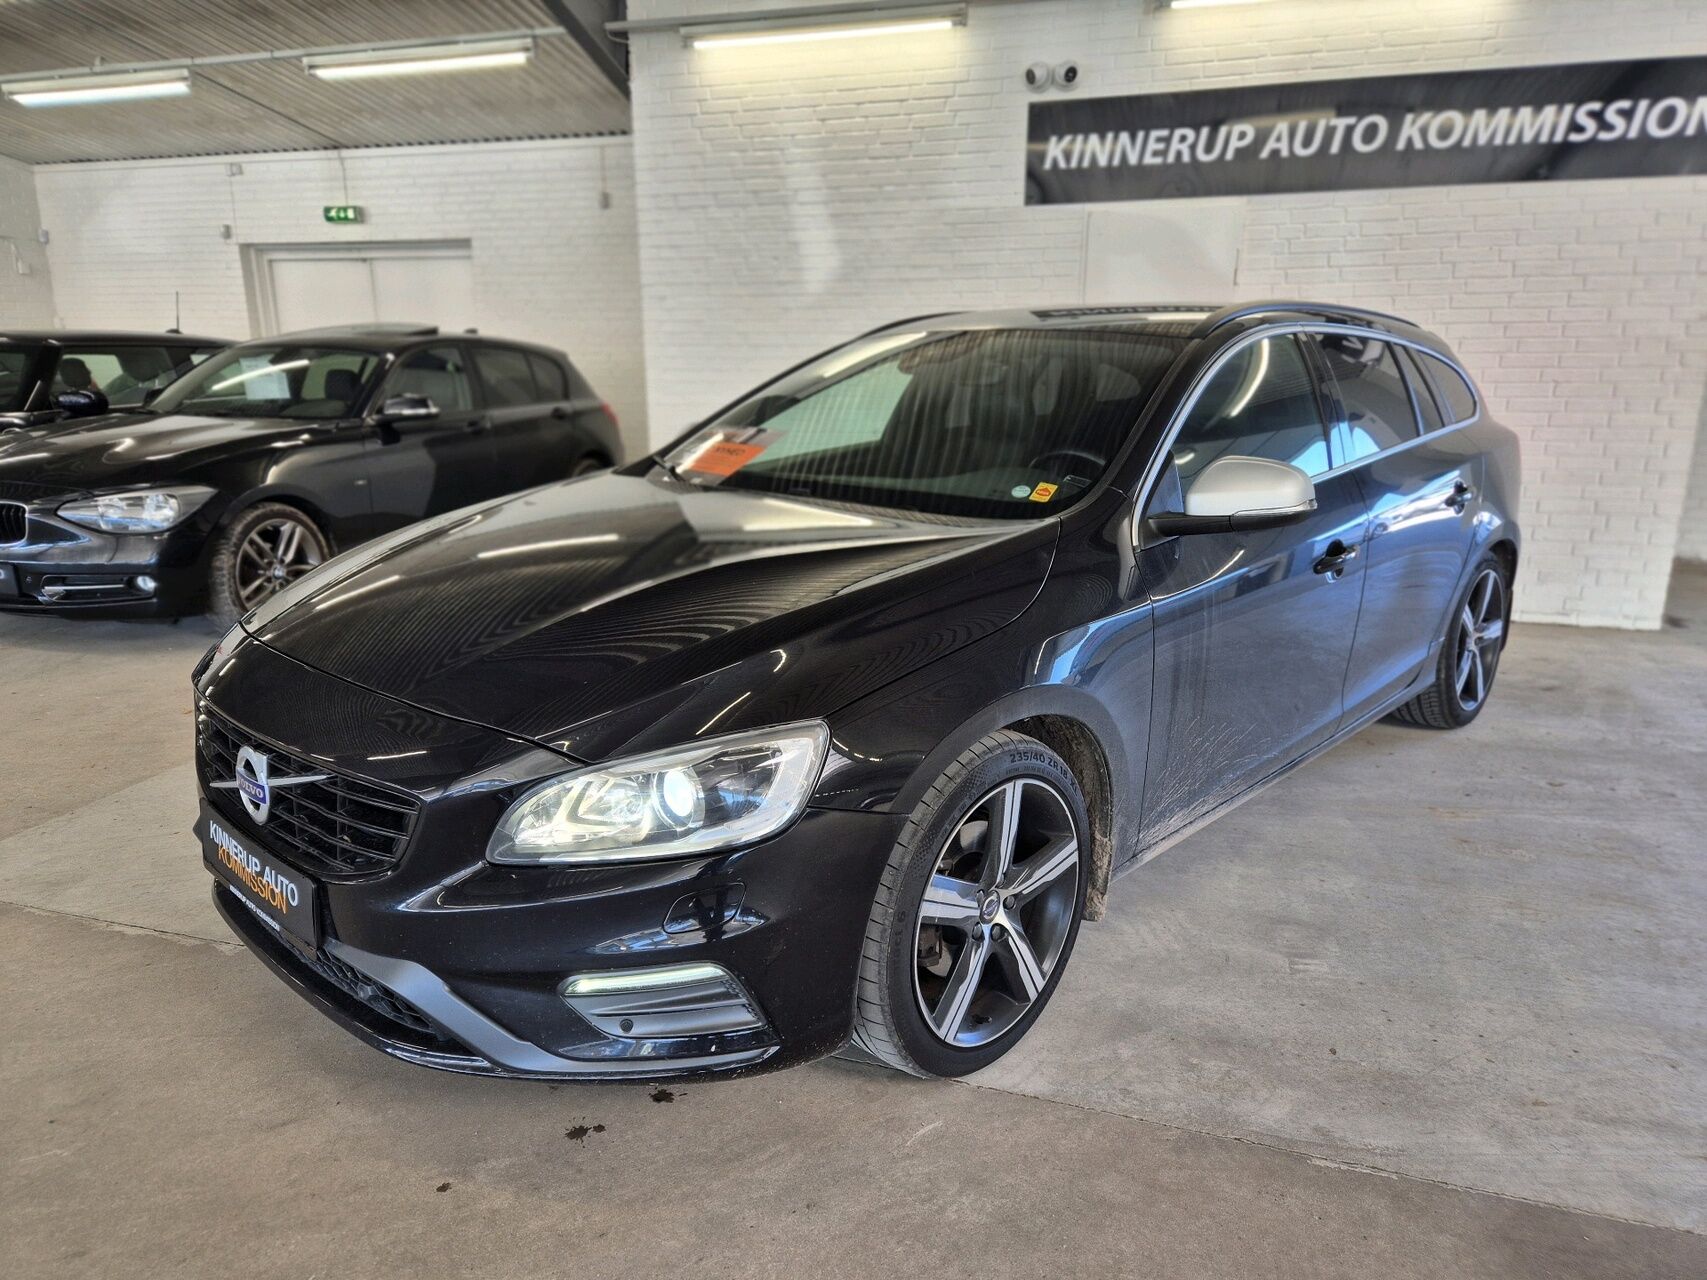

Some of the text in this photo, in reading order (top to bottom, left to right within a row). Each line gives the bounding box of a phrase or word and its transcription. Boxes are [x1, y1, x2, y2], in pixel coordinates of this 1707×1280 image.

[1043, 123, 1256, 170] KINNERUP
[1259, 114, 1388, 160] AUTO
[1009, 751, 1046, 763] 235/40
[237, 775, 264, 798] VOLVO
[209, 820, 299, 907] KINNERUP AUTO
[218, 843, 287, 914] KOMMISSION
